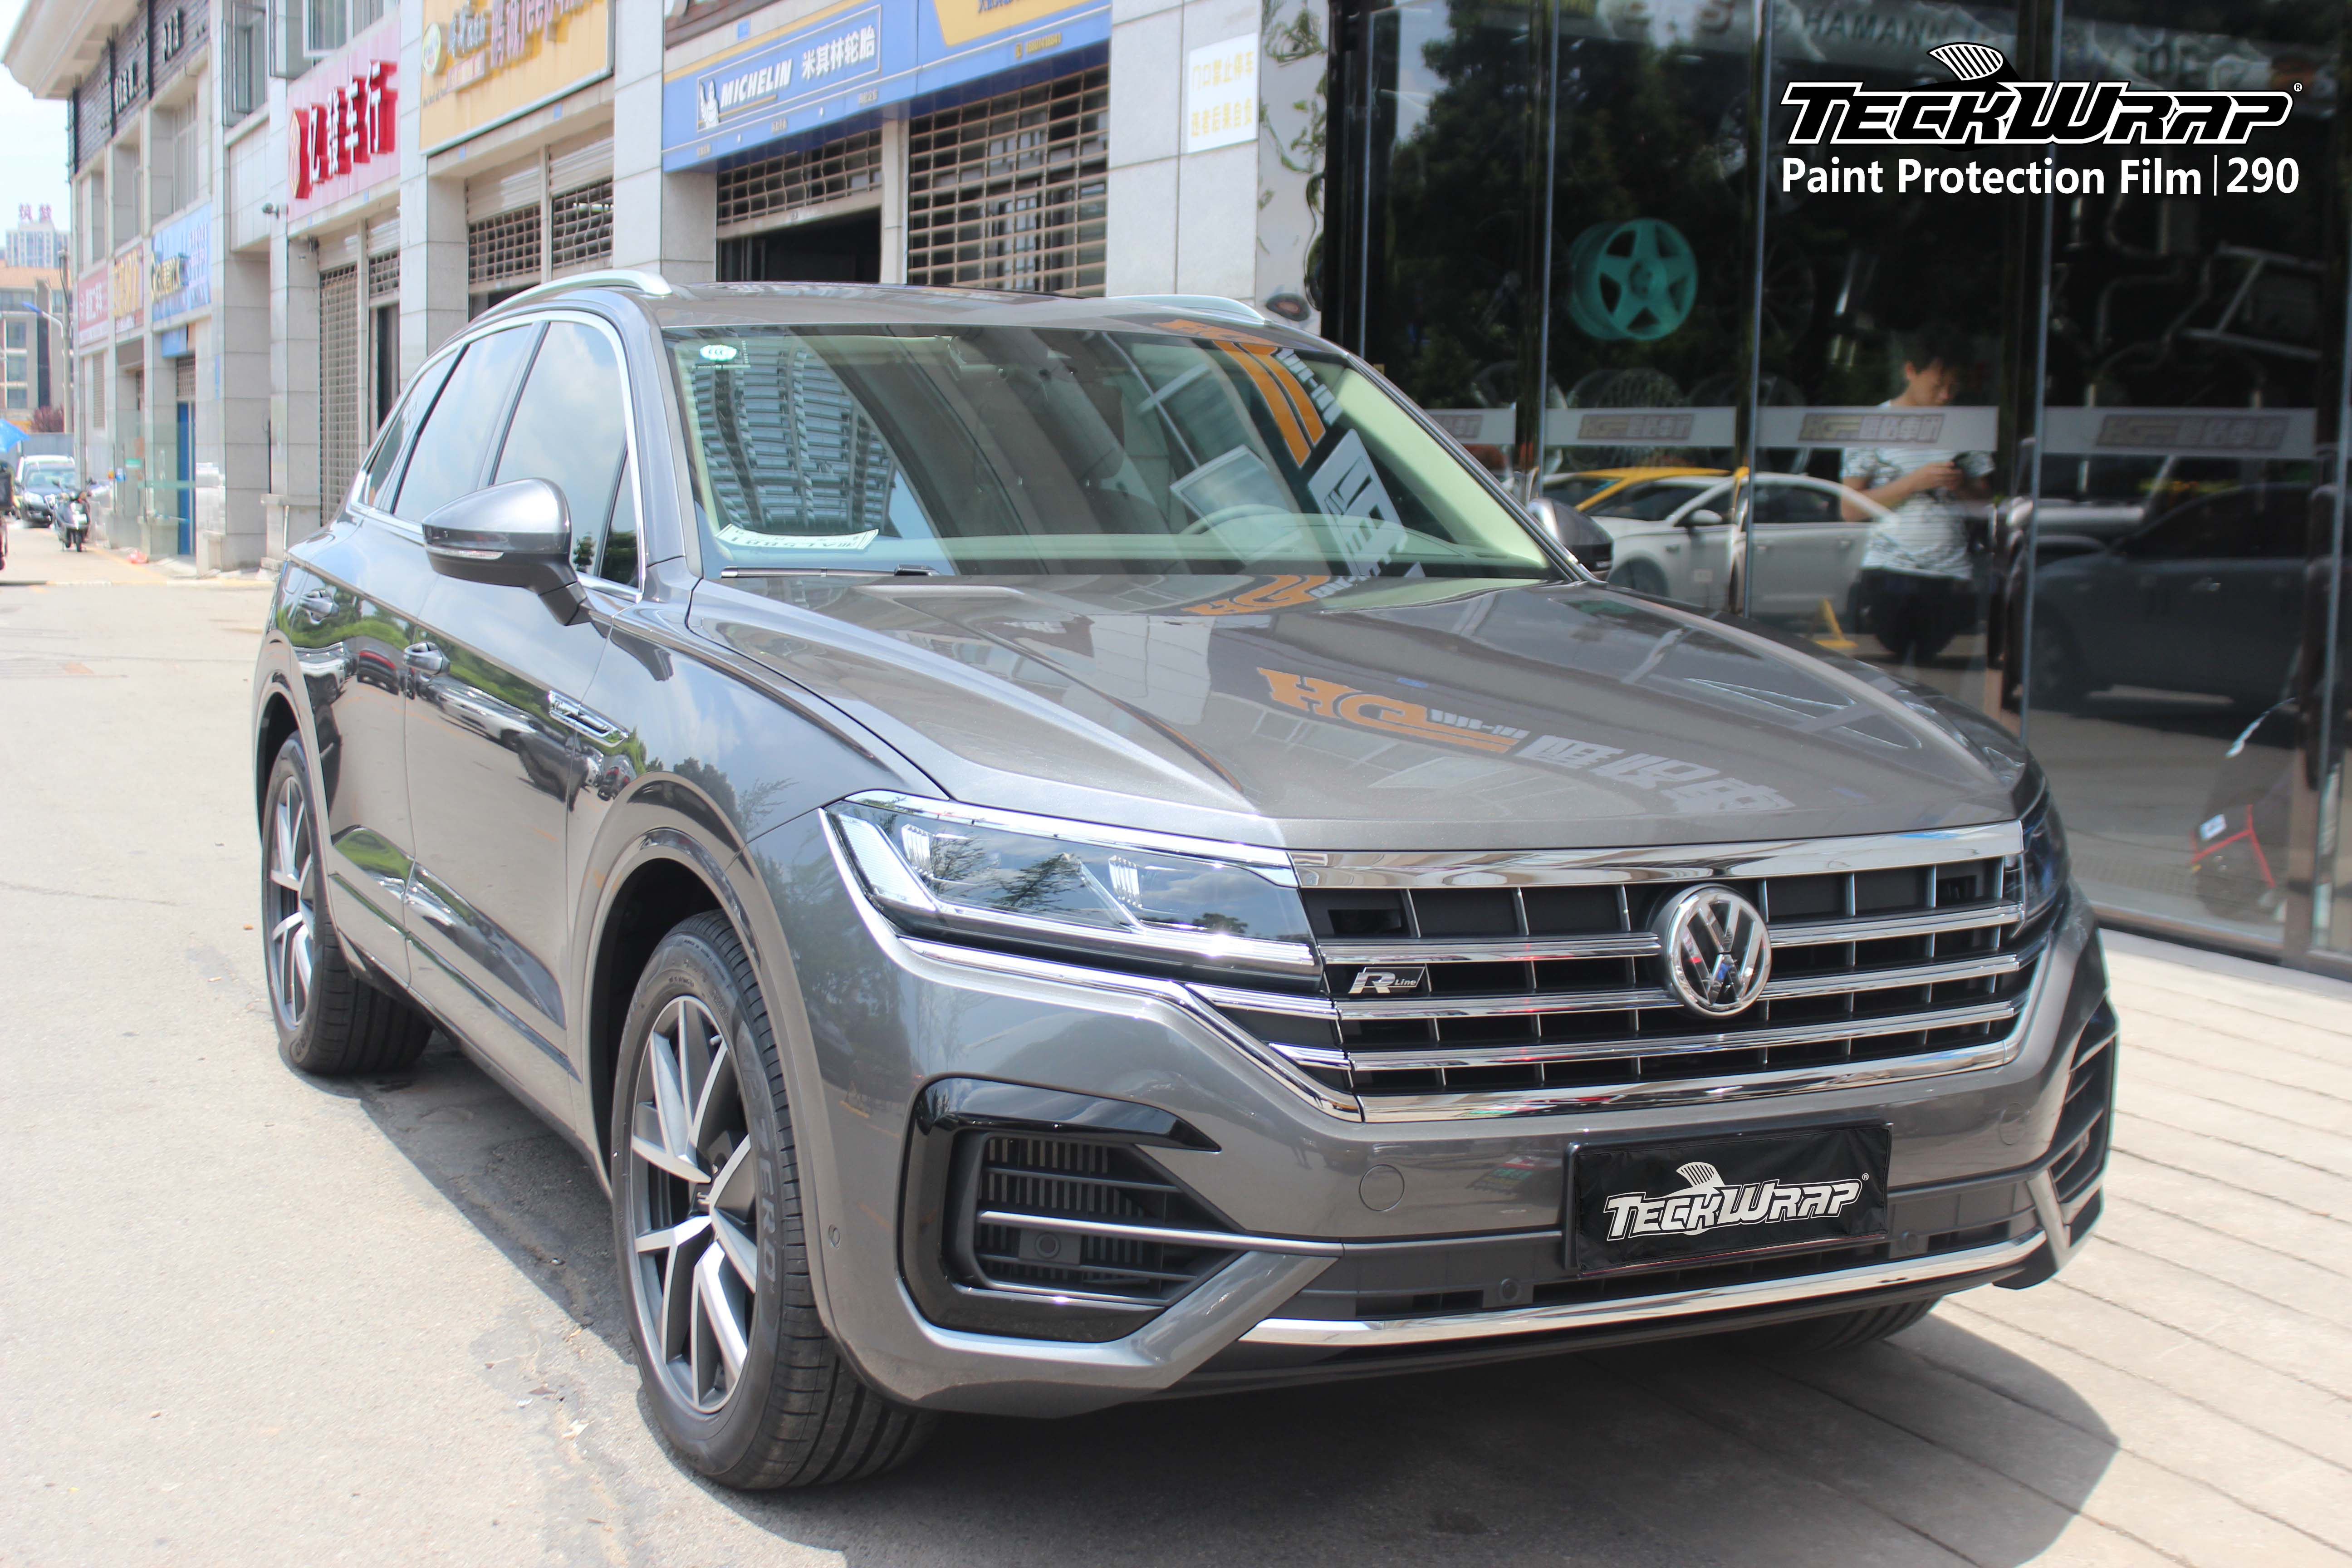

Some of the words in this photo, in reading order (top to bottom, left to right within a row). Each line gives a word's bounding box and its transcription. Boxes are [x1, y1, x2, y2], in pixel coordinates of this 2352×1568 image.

[720, 58, 793, 108] MICHELIN
[802, 25, 875, 80] 米其林轮胎
[1193, 51, 1254, 90] 门口禁止停车
[1191, 97, 1252, 137] 违者后果自负
[1349, 972, 1396, 994] R
